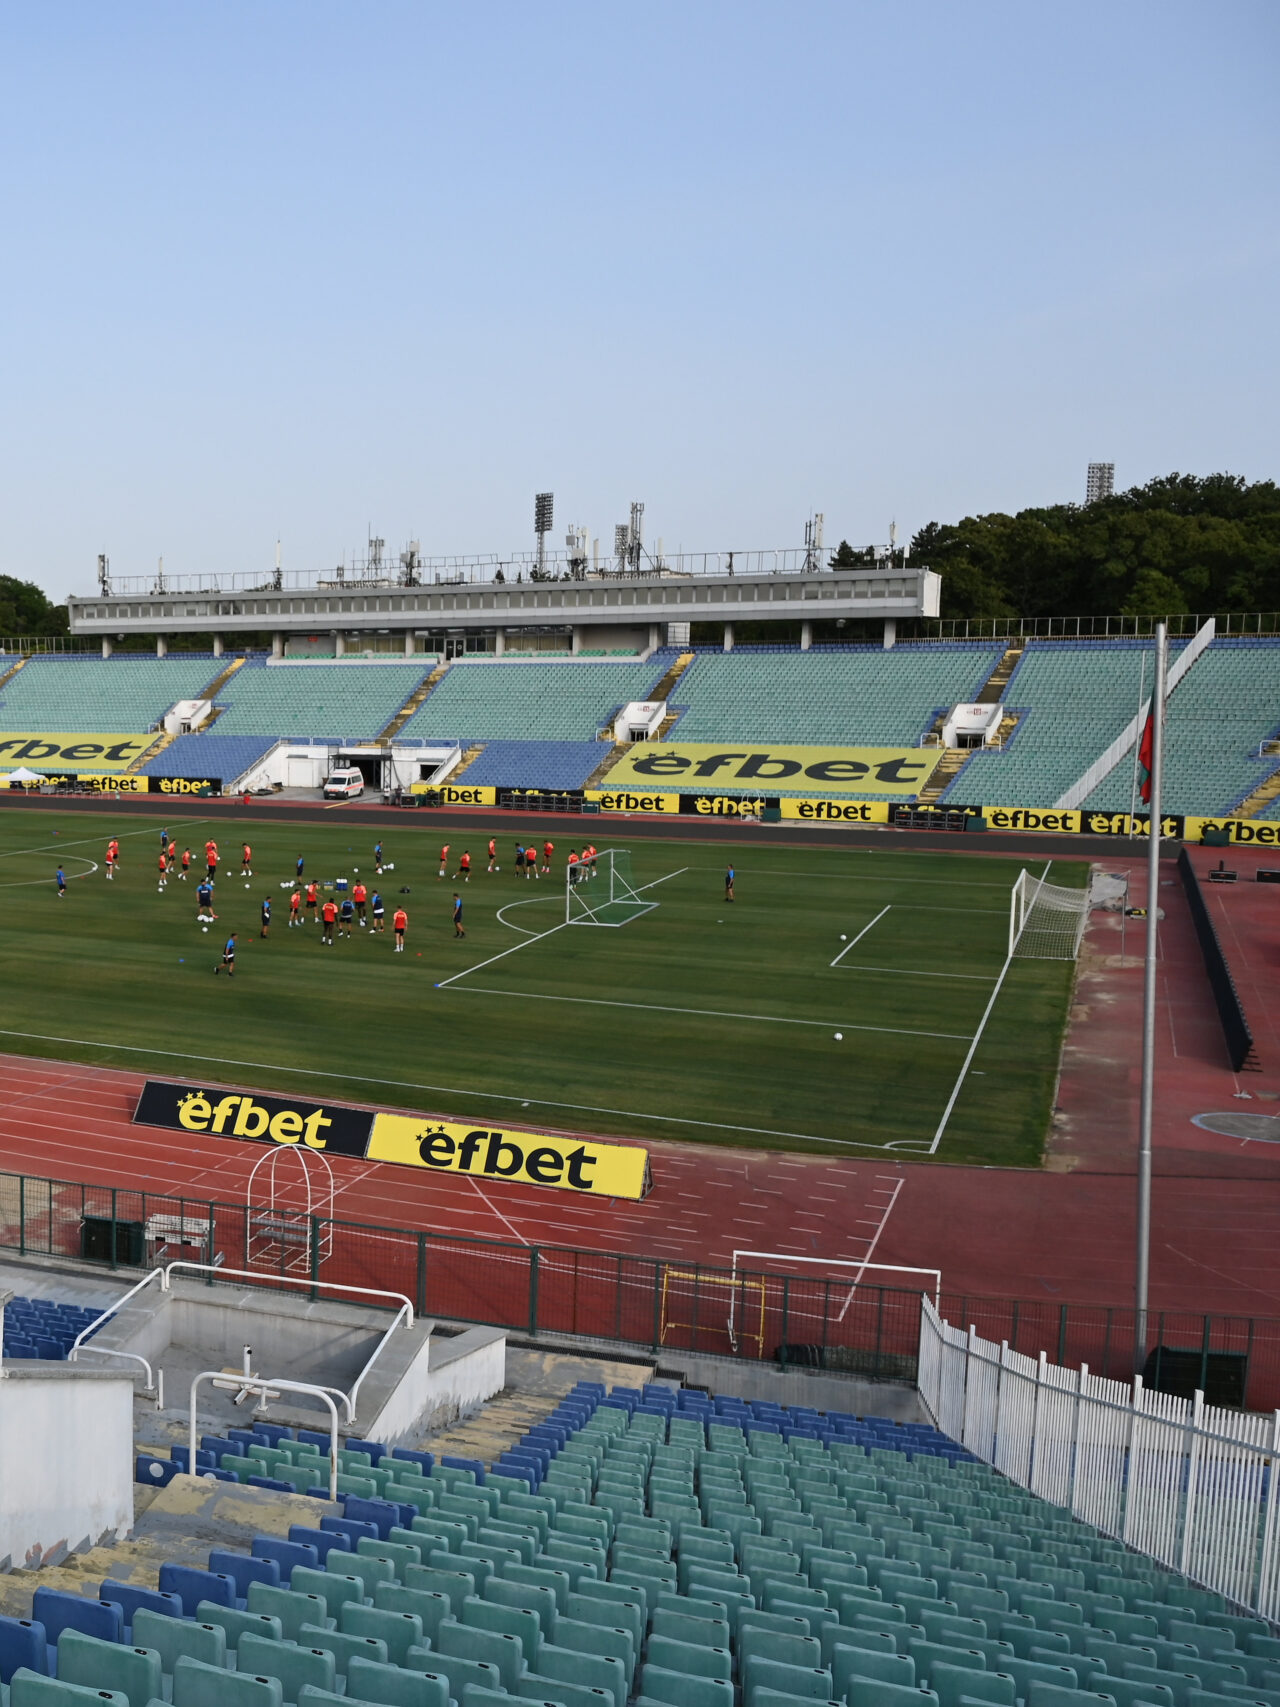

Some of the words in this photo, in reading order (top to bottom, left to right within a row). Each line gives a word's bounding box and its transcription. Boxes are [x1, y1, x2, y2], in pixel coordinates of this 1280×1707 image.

[632, 753, 926, 783] efbet
[91, 776, 138, 791] efbet
[601, 793, 665, 811] efbet
[798, 802, 871, 820] efbet
[991, 810, 1074, 831] efbet
[179, 1096, 332, 1149] efbet
[419, 1131, 597, 1188] efbet
